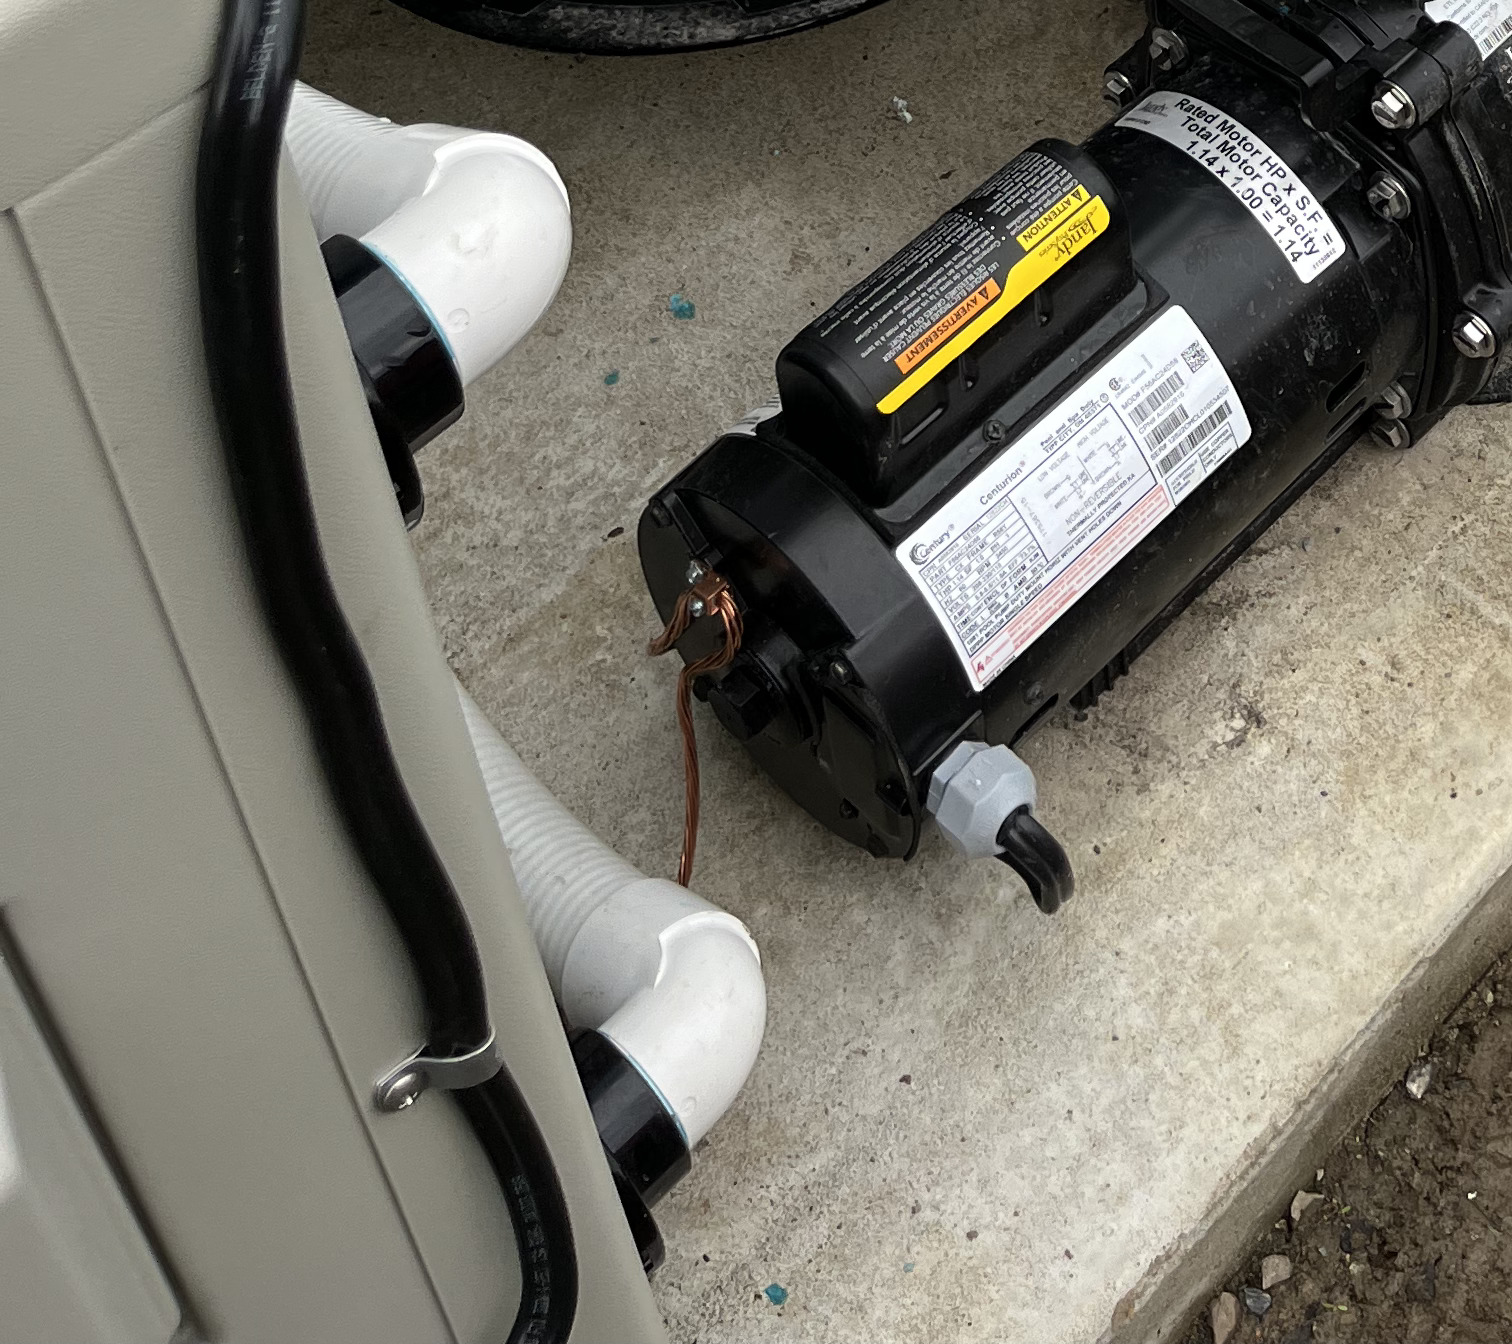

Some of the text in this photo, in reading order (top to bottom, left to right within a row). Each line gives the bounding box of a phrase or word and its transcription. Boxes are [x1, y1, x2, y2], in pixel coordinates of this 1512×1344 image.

[1174, 98, 1334, 245] Rated Motor HP x S.F. =
[1180, 115, 1320, 257] Total Motor Capacity
[1021, 196, 1073, 242] ATTENTION
[1186, 140, 1304, 263] 1.14 x 1.00 = 1.14
[1052, 214, 1098, 263] Jandy
[905, 296, 979, 362] AVERTISSEMENT
[977, 464, 1023, 506] Centurion
[918, 528, 952, 560] Century
